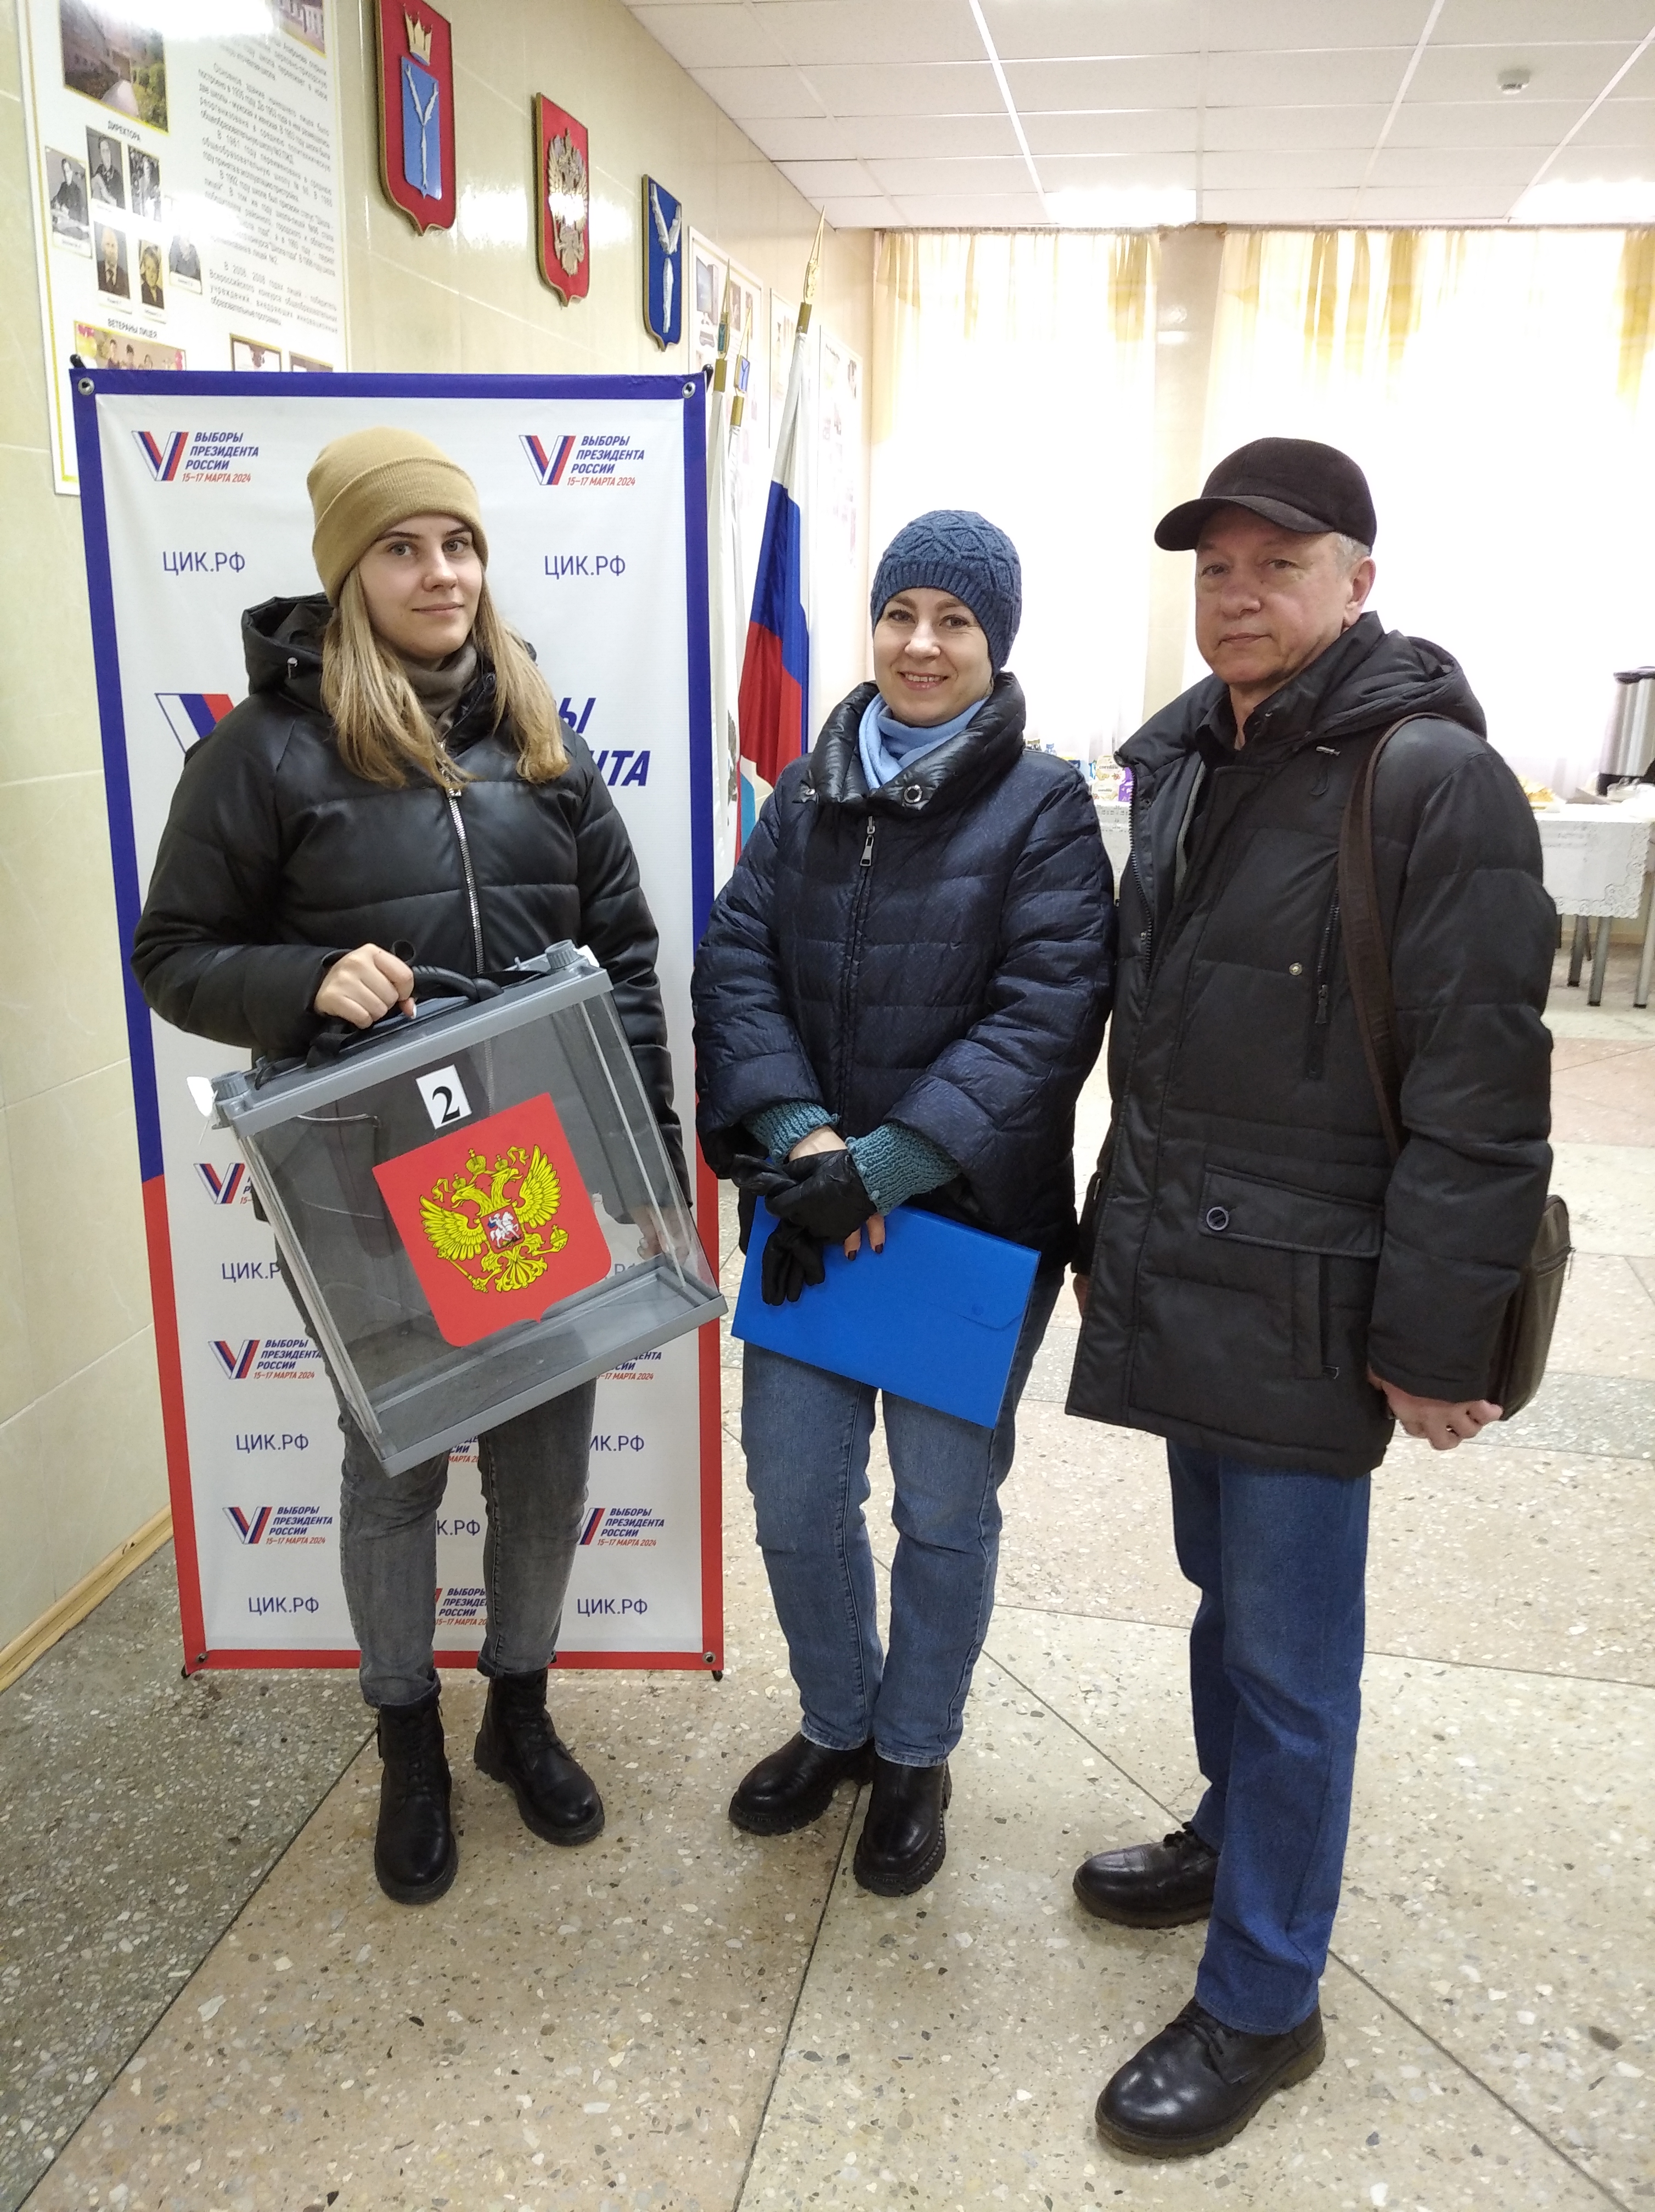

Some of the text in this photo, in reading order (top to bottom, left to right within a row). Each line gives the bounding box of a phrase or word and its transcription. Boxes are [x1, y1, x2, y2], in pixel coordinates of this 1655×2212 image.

[194, 432, 244, 443] ВЫБОРЫ
[581, 436, 630, 446] ВЫБОРЫ
[190, 445, 259, 458] ПРЕЗИДЕНТА
[576, 449, 645, 461] ПРЕЗИДЕНТА
[185, 460, 229, 470] РОССИИ
[571, 464, 615, 474] РОССИИ
[205, 473, 233, 483] МАРТА
[233, 473, 251, 483] 2024
[589, 477, 617, 486] МАРТА
[618, 477, 636, 486] 2024
[163, 551, 245, 575] ЦИК.РФ
[545, 555, 626, 580] ЦИК.РФ
[432, 1086, 460, 1124] 2
[222, 1262, 280, 1283] ЦИК.Р
[257, 1361, 296, 1369] РОССИИ
[236, 1434, 309, 1454] ЦИК.РФ
[590, 1435, 644, 1452] ИК.РФ
[277, 1506, 320, 1515] ВЫБОРЫ
[273, 1516, 333, 1526] ПРЕЗИДЕНТА
[605, 1519, 665, 1527] ПРЕЗИДЕНТА
[269, 1527, 307, 1535] РОССИИ
[437, 1520, 480, 1536] К.РФ
[249, 1597, 319, 1616] ЦИК.РФ
[443, 1598, 487, 1607] ПРЕЗИДЕ
[577, 1598, 648, 1617] ЦИК.РФ
